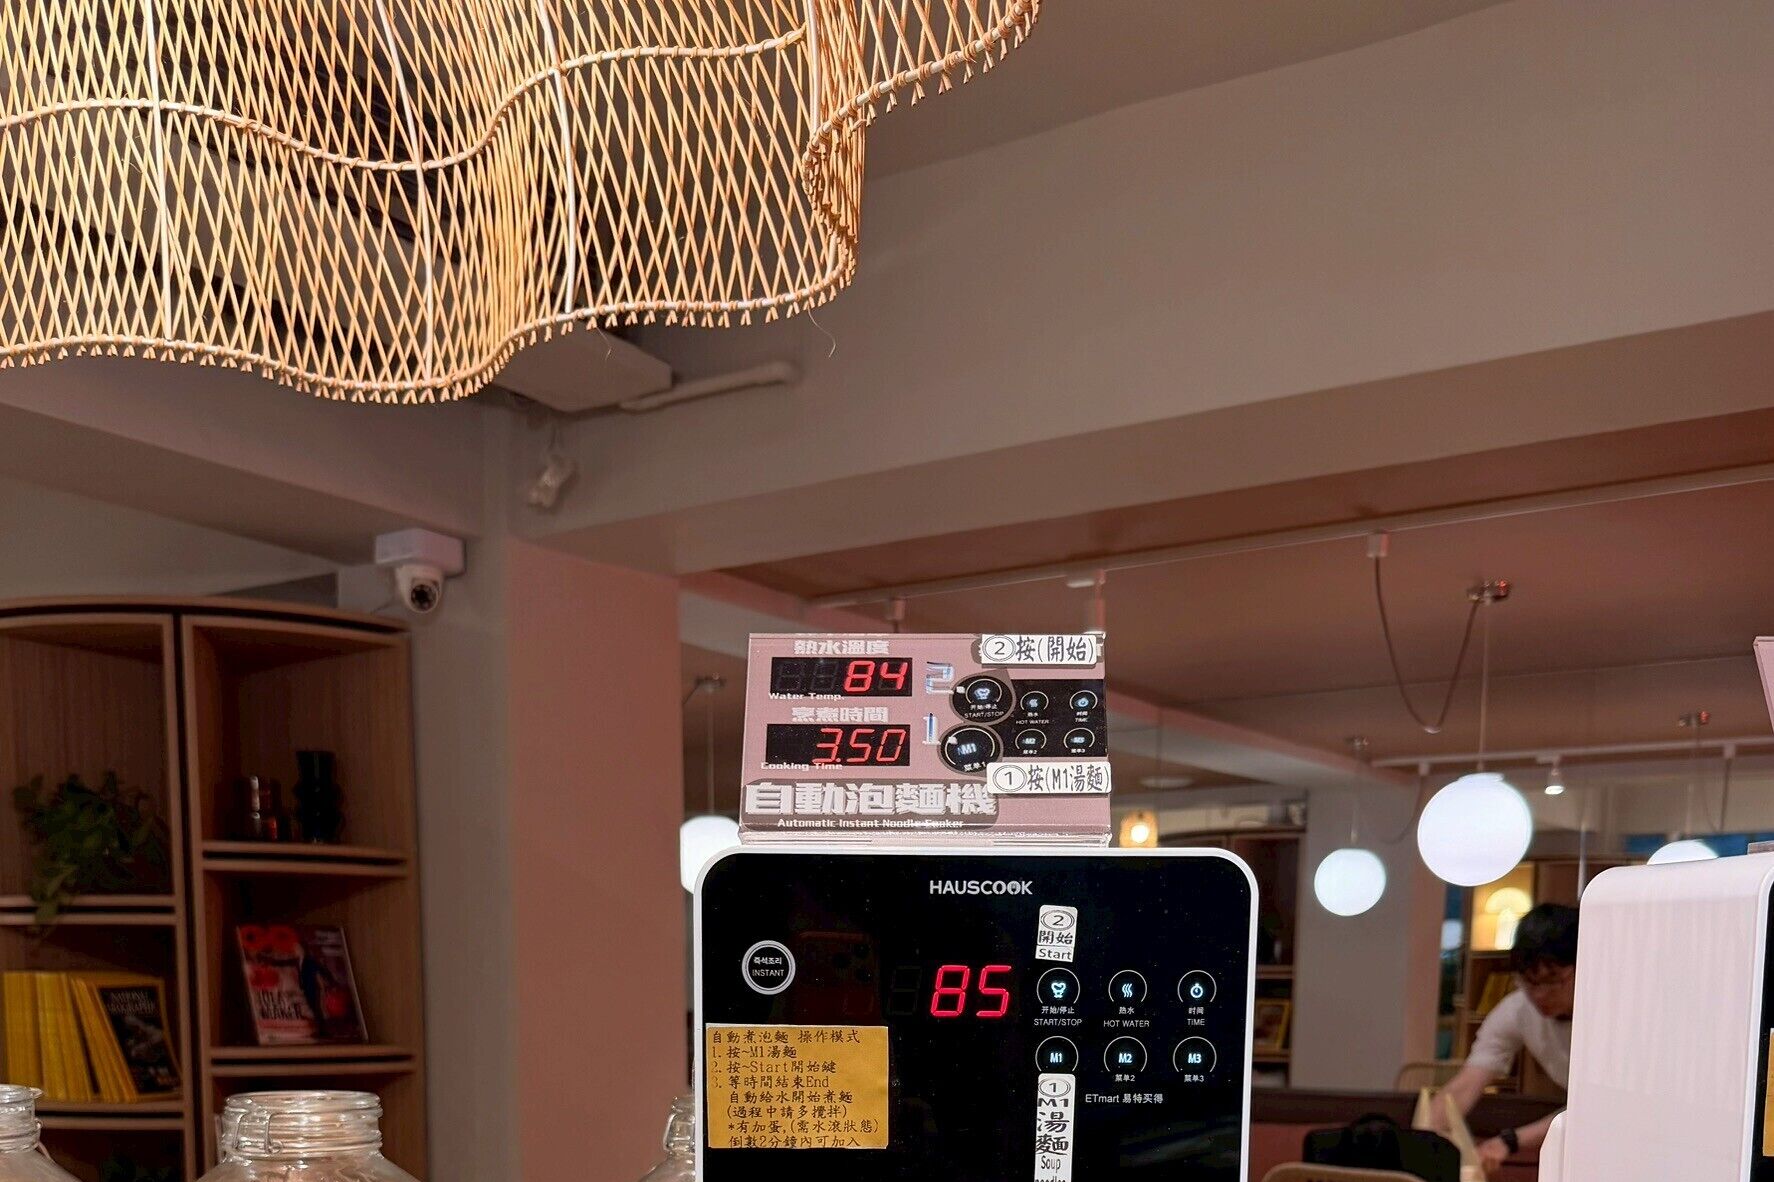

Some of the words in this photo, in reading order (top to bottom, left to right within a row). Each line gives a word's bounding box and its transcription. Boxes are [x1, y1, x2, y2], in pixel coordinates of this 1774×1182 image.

[843, 660, 909, 692] 84
[769, 692, 804, 700] Water
[964, 711, 1005, 719] START/STOP
[761, 762, 810, 771] Cooking
[815, 762, 843, 770] Time
[745, 782, 998, 815] 自動泡麵機
[777, 818, 836, 828] Automatic
[839, 818, 880, 828] Instant
[929, 880, 1033, 895] HAUSCOOK
[1038, 930, 1073, 945] 開始
[1038, 948, 1072, 960] Start
[752, 968, 785, 977] INSTANT
[929, 964, 1012, 1017] 85
[1041, 1006, 1075, 1014] 开始/停止
[1033, 1018, 1083, 1026] START/STOP
[1103, 1020, 1121, 1028] HOT
[1122, 1020, 1150, 1028] WATER
[1187, 1018, 1206, 1026] TIME
[712, 1030, 789, 1044] 自動煮泡麵
[797, 1030, 861, 1044] 操作模式
[1049, 1053, 1063, 1063] M1
[1118, 1053, 1133, 1064] M2
[1188, 1053, 1202, 1064] M3
[729, 1090, 853, 1103] 自動給水開始煮麵
[1085, 1094, 1120, 1103] ETmart
[1122, 1093, 1164, 1104] 易特买得
[1037, 1098, 1069, 1107] M1
[727, 1105, 848, 1119] (過程中請多攪拌)
[729, 1135, 861, 1148] 倒數2分鐘內可加入
[1040, 1155, 1061, 1173] Soup
